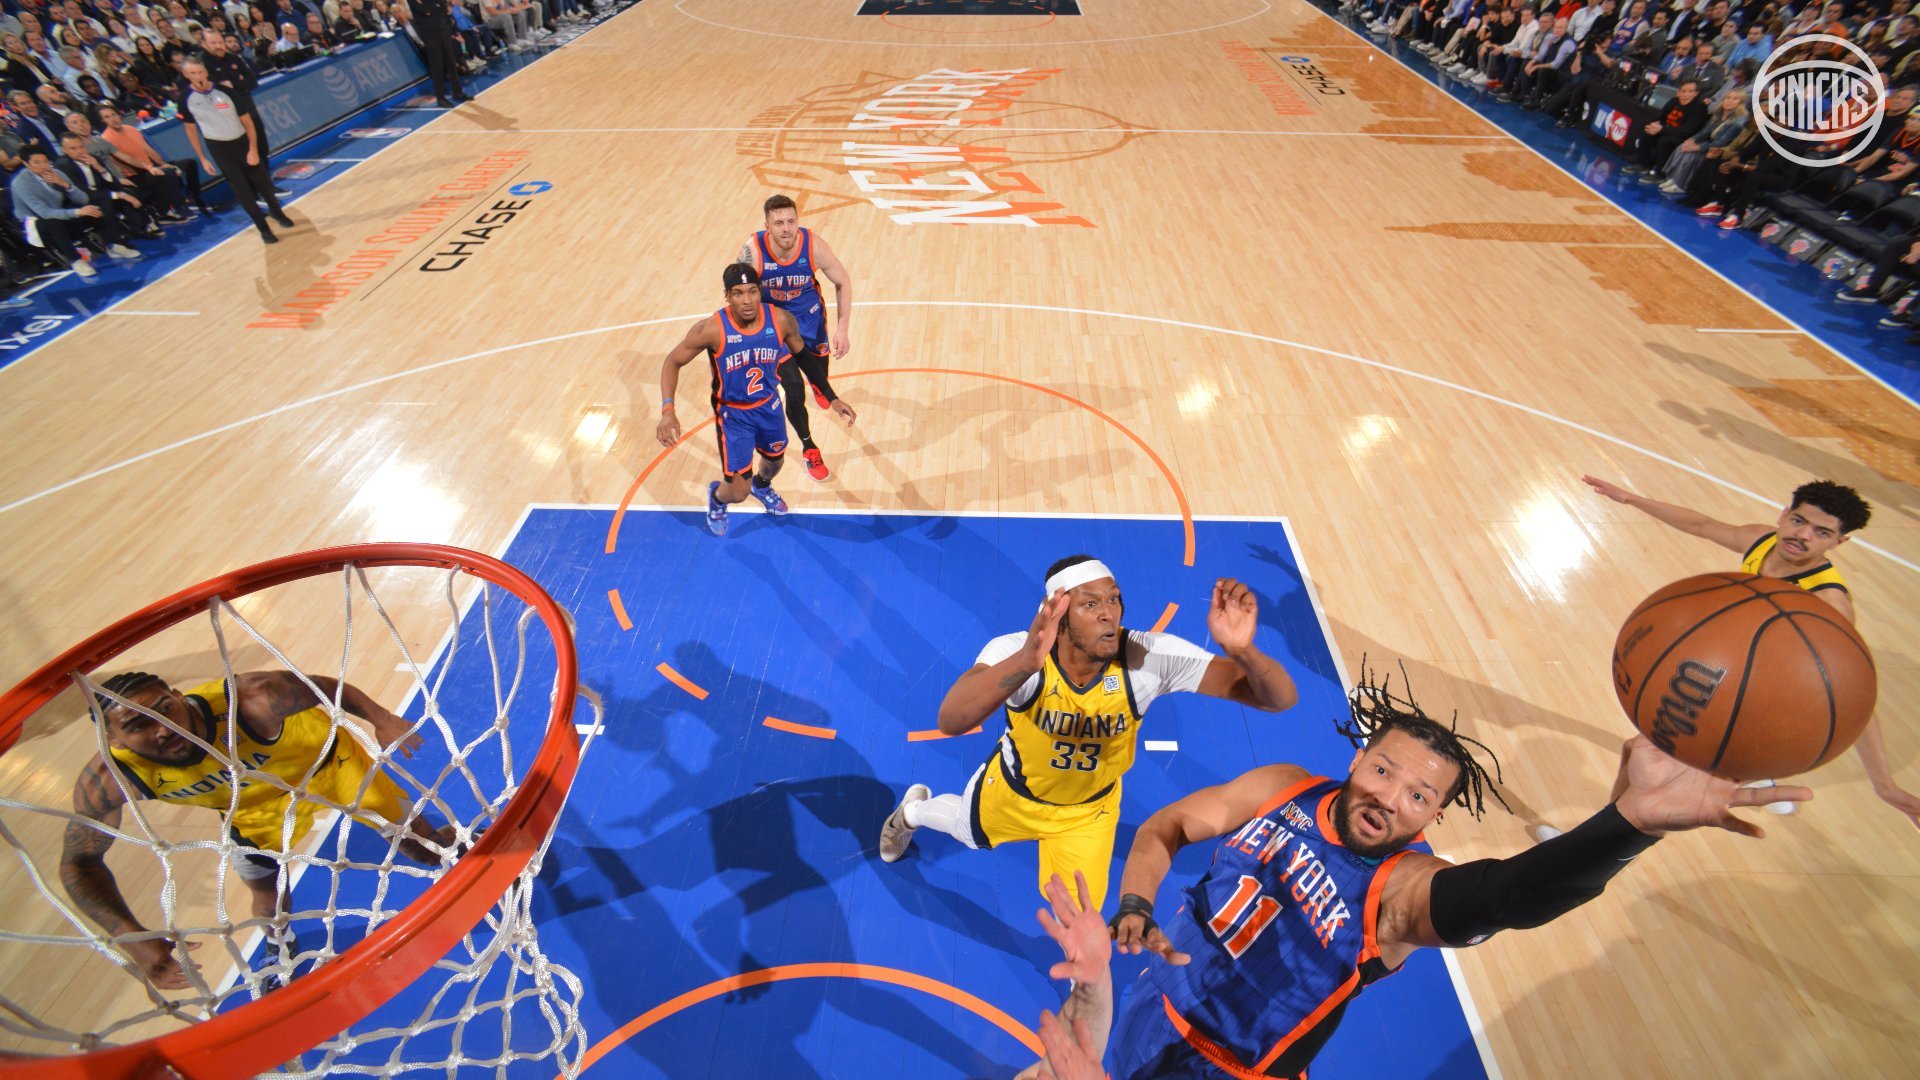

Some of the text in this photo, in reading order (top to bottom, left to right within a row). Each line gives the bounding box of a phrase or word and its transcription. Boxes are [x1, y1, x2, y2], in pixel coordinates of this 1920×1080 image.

[351, 53, 397, 92] AT&T
[1291, 65, 1346, 95] CHASE
[255, 93, 302, 136] T&T
[842, 67, 1044, 228] NEW YORK
[244, 150, 530, 329] MADISON SQUARE GARDEN
[419, 199, 533, 273] CHASE
[761, 275, 784, 289] NEW
[0, 315, 74, 350] ixel
[725, 348, 751, 372] NEW
[745, 367, 764, 396] 2
[1033, 706, 1127, 739] INDIANA
[1651, 659, 1728, 758] Wilso
[1050, 740, 1102, 772] 33
[1280, 800, 1314, 832] NYC
[1229, 816, 1351, 942] NEW YORK
[1207, 874, 1283, 961] 11
